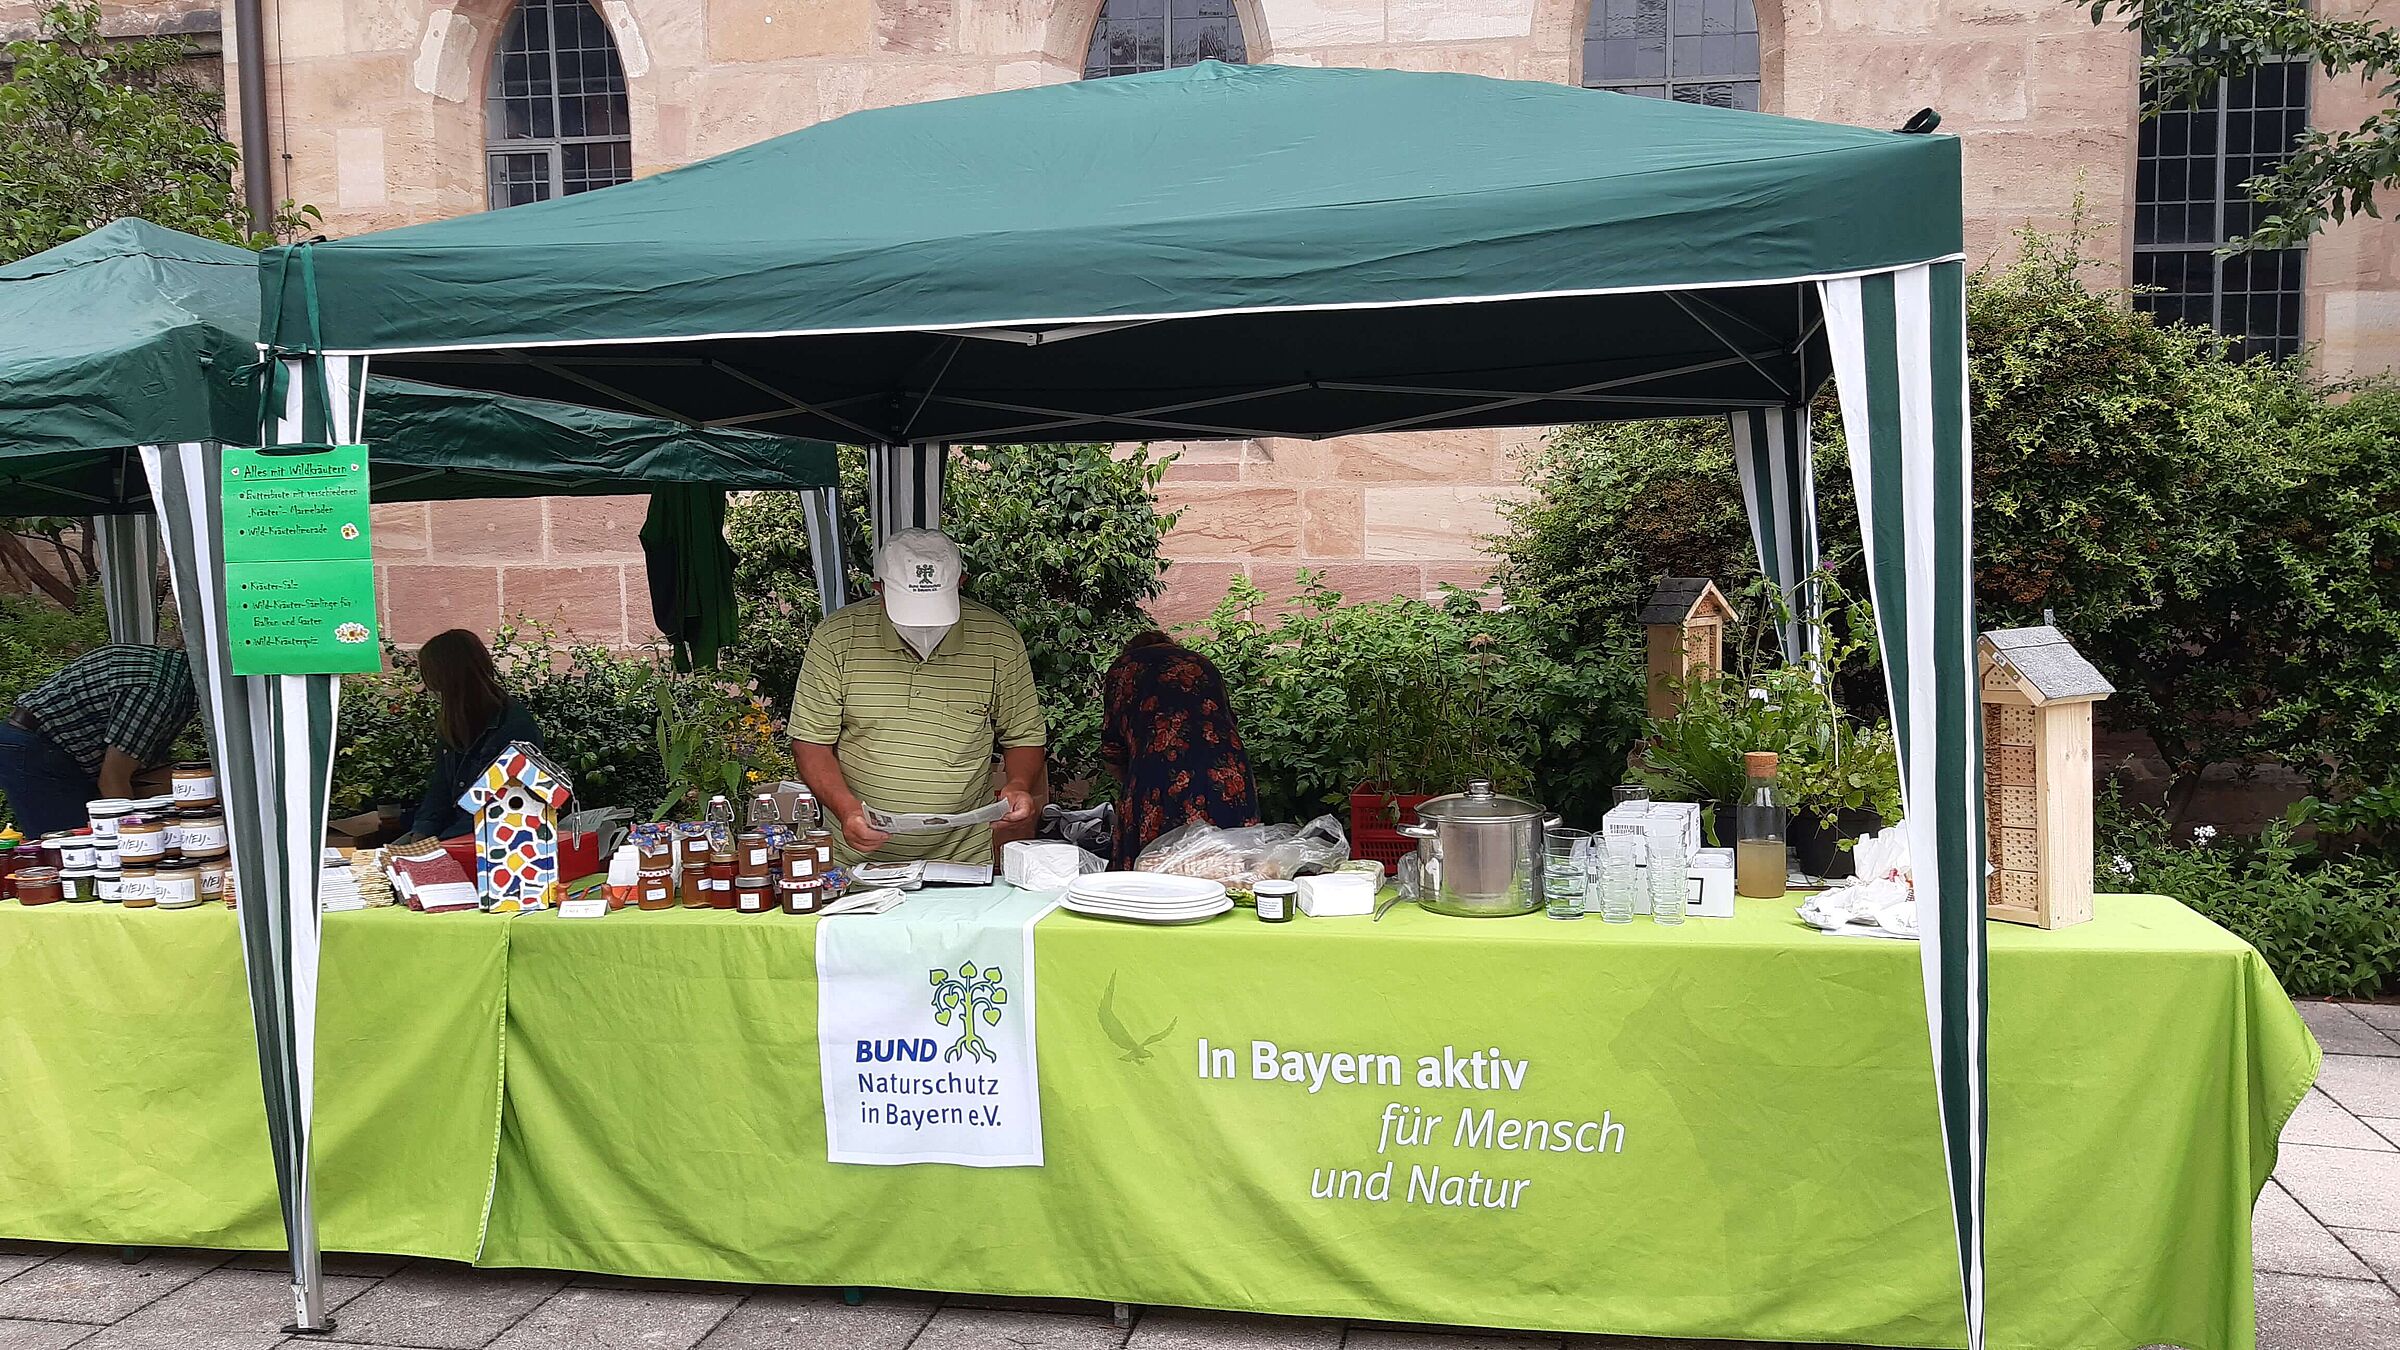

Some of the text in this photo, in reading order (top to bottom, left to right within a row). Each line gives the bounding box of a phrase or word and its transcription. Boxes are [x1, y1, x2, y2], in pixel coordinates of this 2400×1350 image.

[244, 463, 347, 479] Alles mit Wildkräutern
[293, 488, 304, 498] mit
[856, 1038, 938, 1063] BUND
[1197, 1038, 1529, 1094] In Bayern aktiv
[858, 1071, 999, 1095] Naturschutz
[861, 1101, 1002, 1131] in Bayern e.V.
[1377, 1103, 1626, 1155] für Mensch
[1310, 1161, 1531, 1209] und Natur
